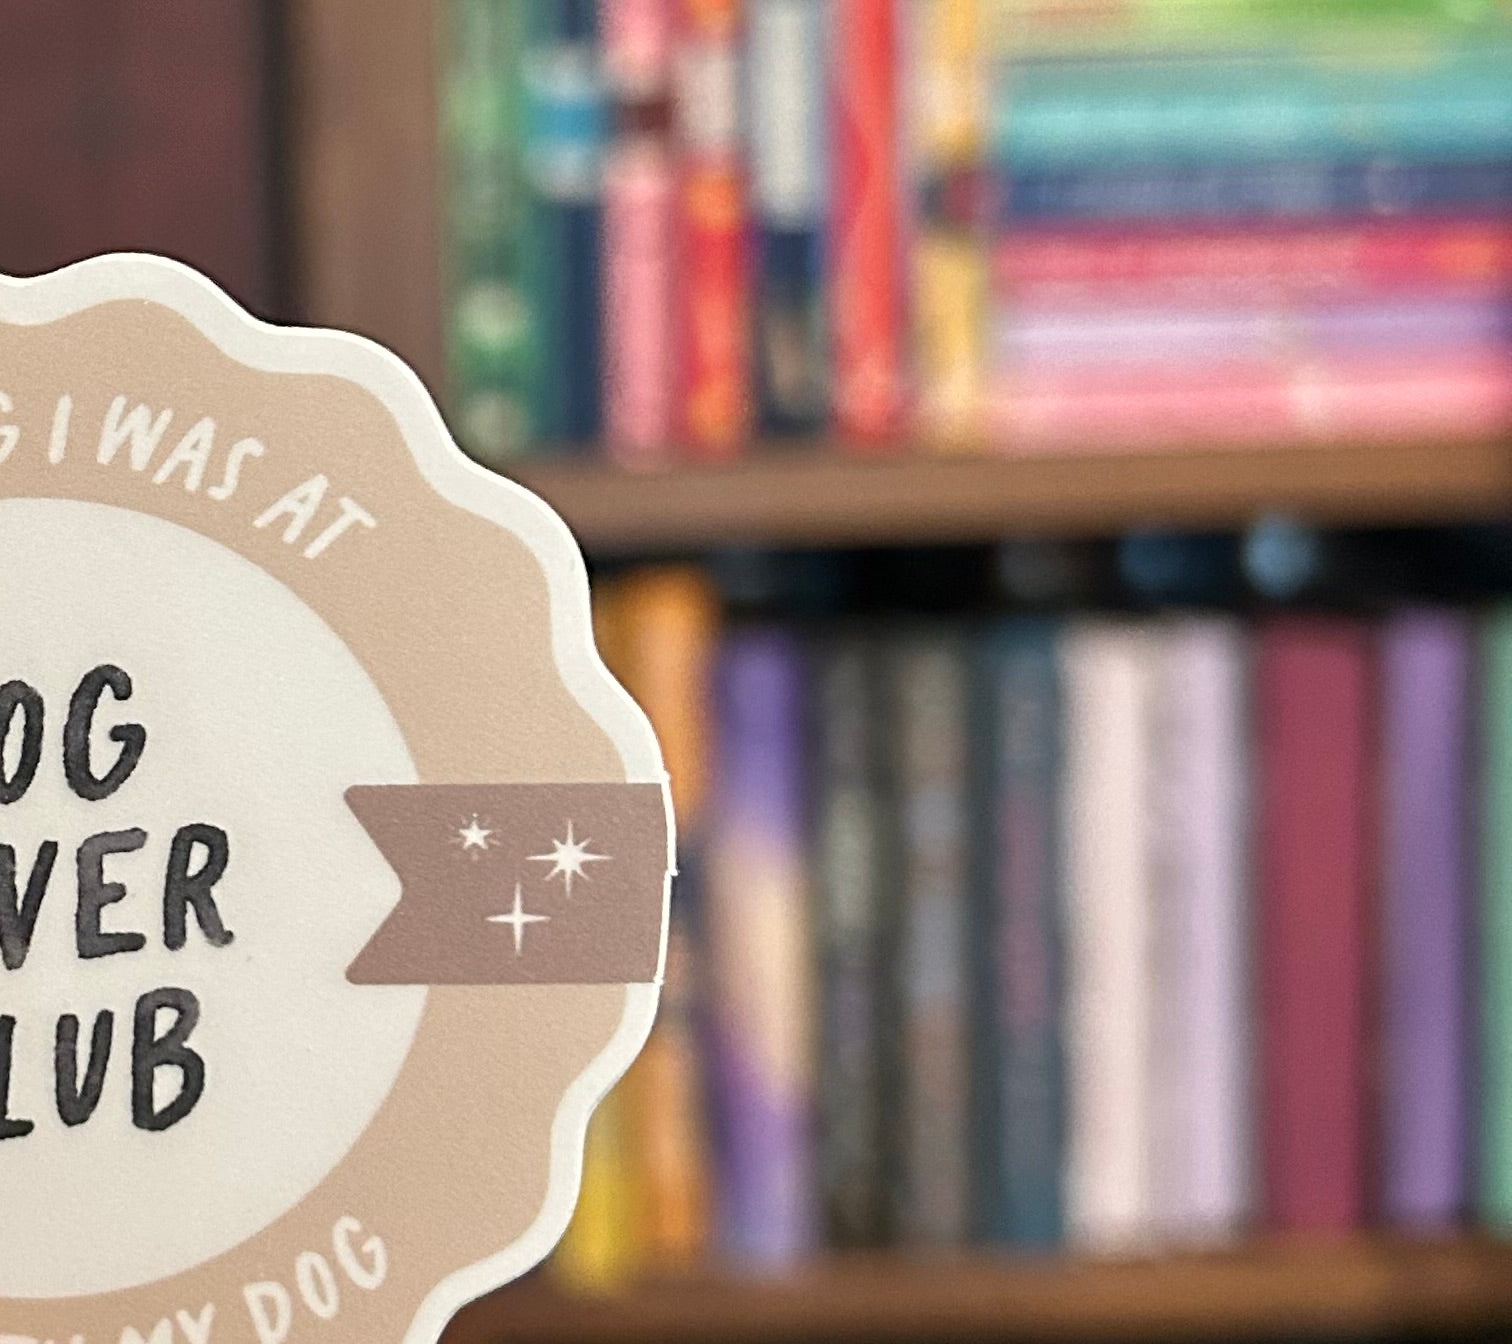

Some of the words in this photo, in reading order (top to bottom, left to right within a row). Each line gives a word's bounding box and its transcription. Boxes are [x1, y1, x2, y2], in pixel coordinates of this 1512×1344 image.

[47, 395, 73, 465] I
[96, 394, 264, 503] WAS
[253, 472, 377, 561] AT
